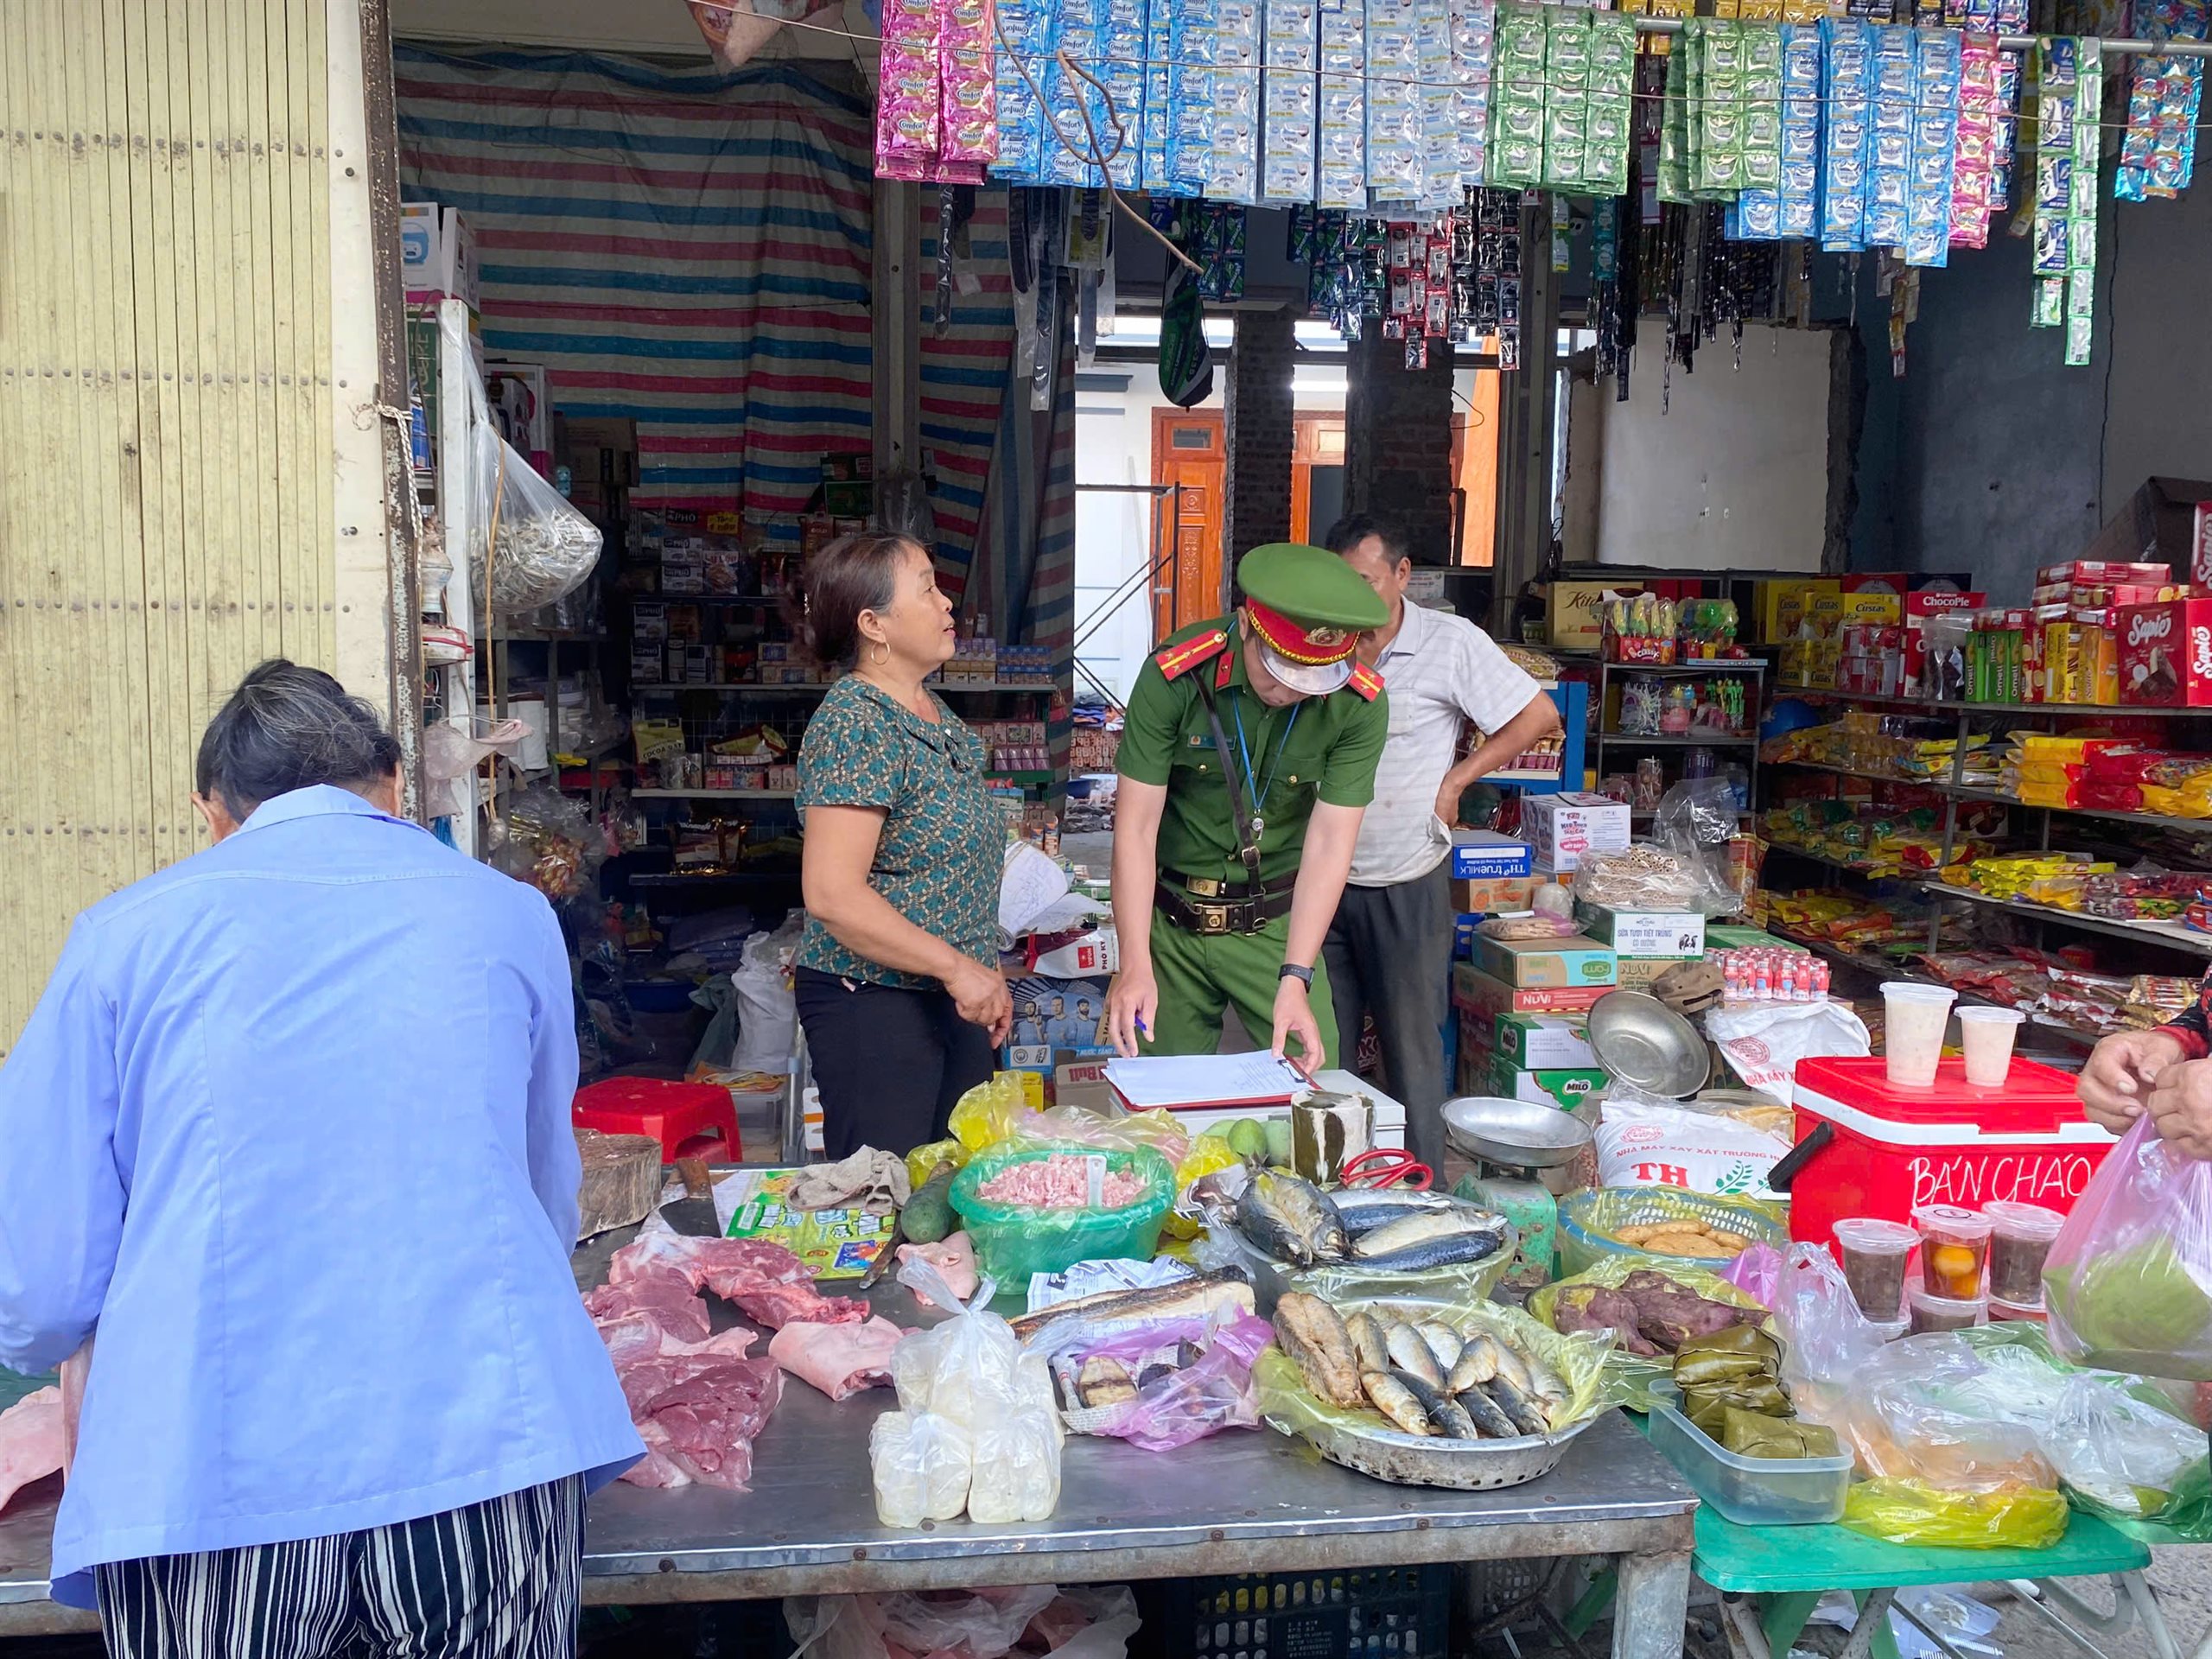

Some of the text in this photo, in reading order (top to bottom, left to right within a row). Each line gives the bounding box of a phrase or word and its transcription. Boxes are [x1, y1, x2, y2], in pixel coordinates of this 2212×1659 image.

[1110, 2, 1136, 12] Comfort
[1059, 37, 1087, 48] Comfort
[1180, 34, 1208, 45] Comfort
[1108, 41, 1135, 53] Comfort
[1179, 74, 1205, 86] Comfort
[1106, 81, 1133, 92] Comfort
[1177, 113, 1203, 124] Comfort
[1052, 156, 1079, 168] Comfort
[1855, 603, 1886, 613] Custas
[1567, 1083, 1589, 1091] MILO
[1630, 1162, 1690, 1187] TH
